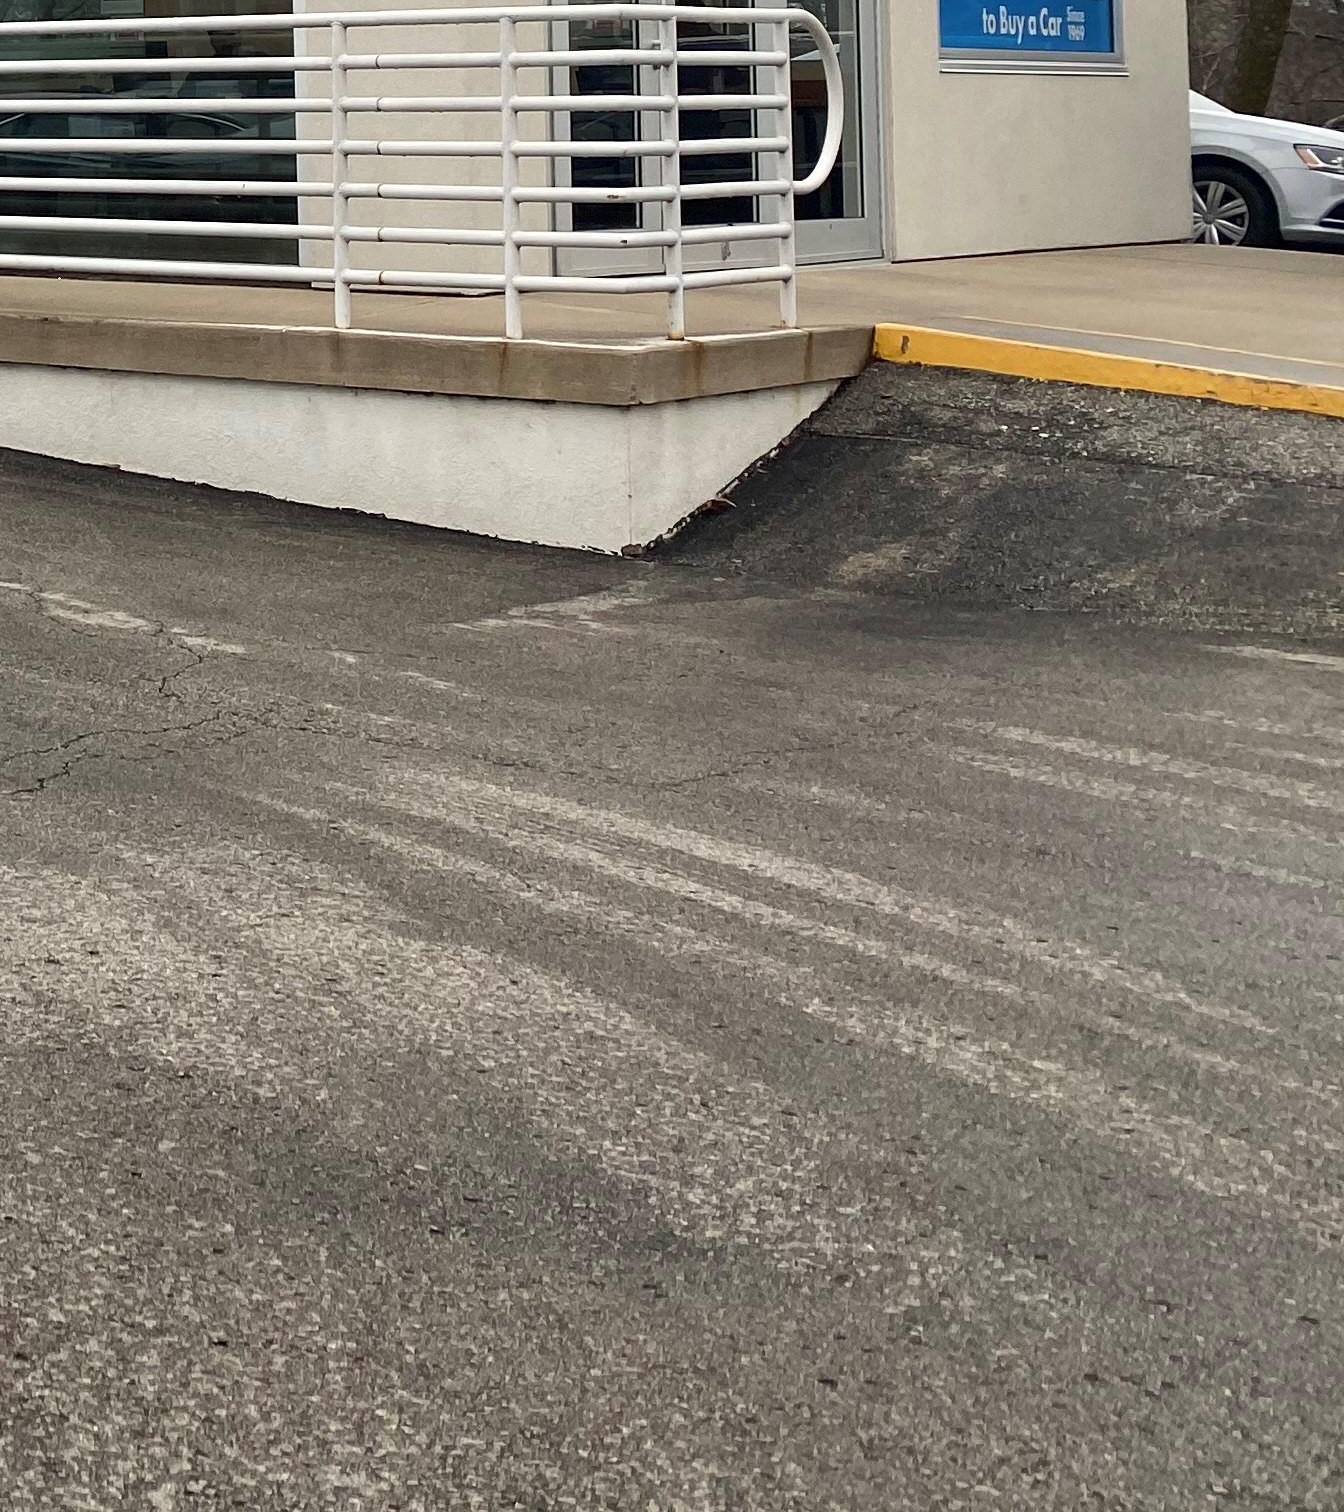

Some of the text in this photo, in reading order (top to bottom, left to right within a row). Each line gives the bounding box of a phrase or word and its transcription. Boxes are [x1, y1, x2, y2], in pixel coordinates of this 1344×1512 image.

[983, 6, 1063, 45] to Buy a Car
